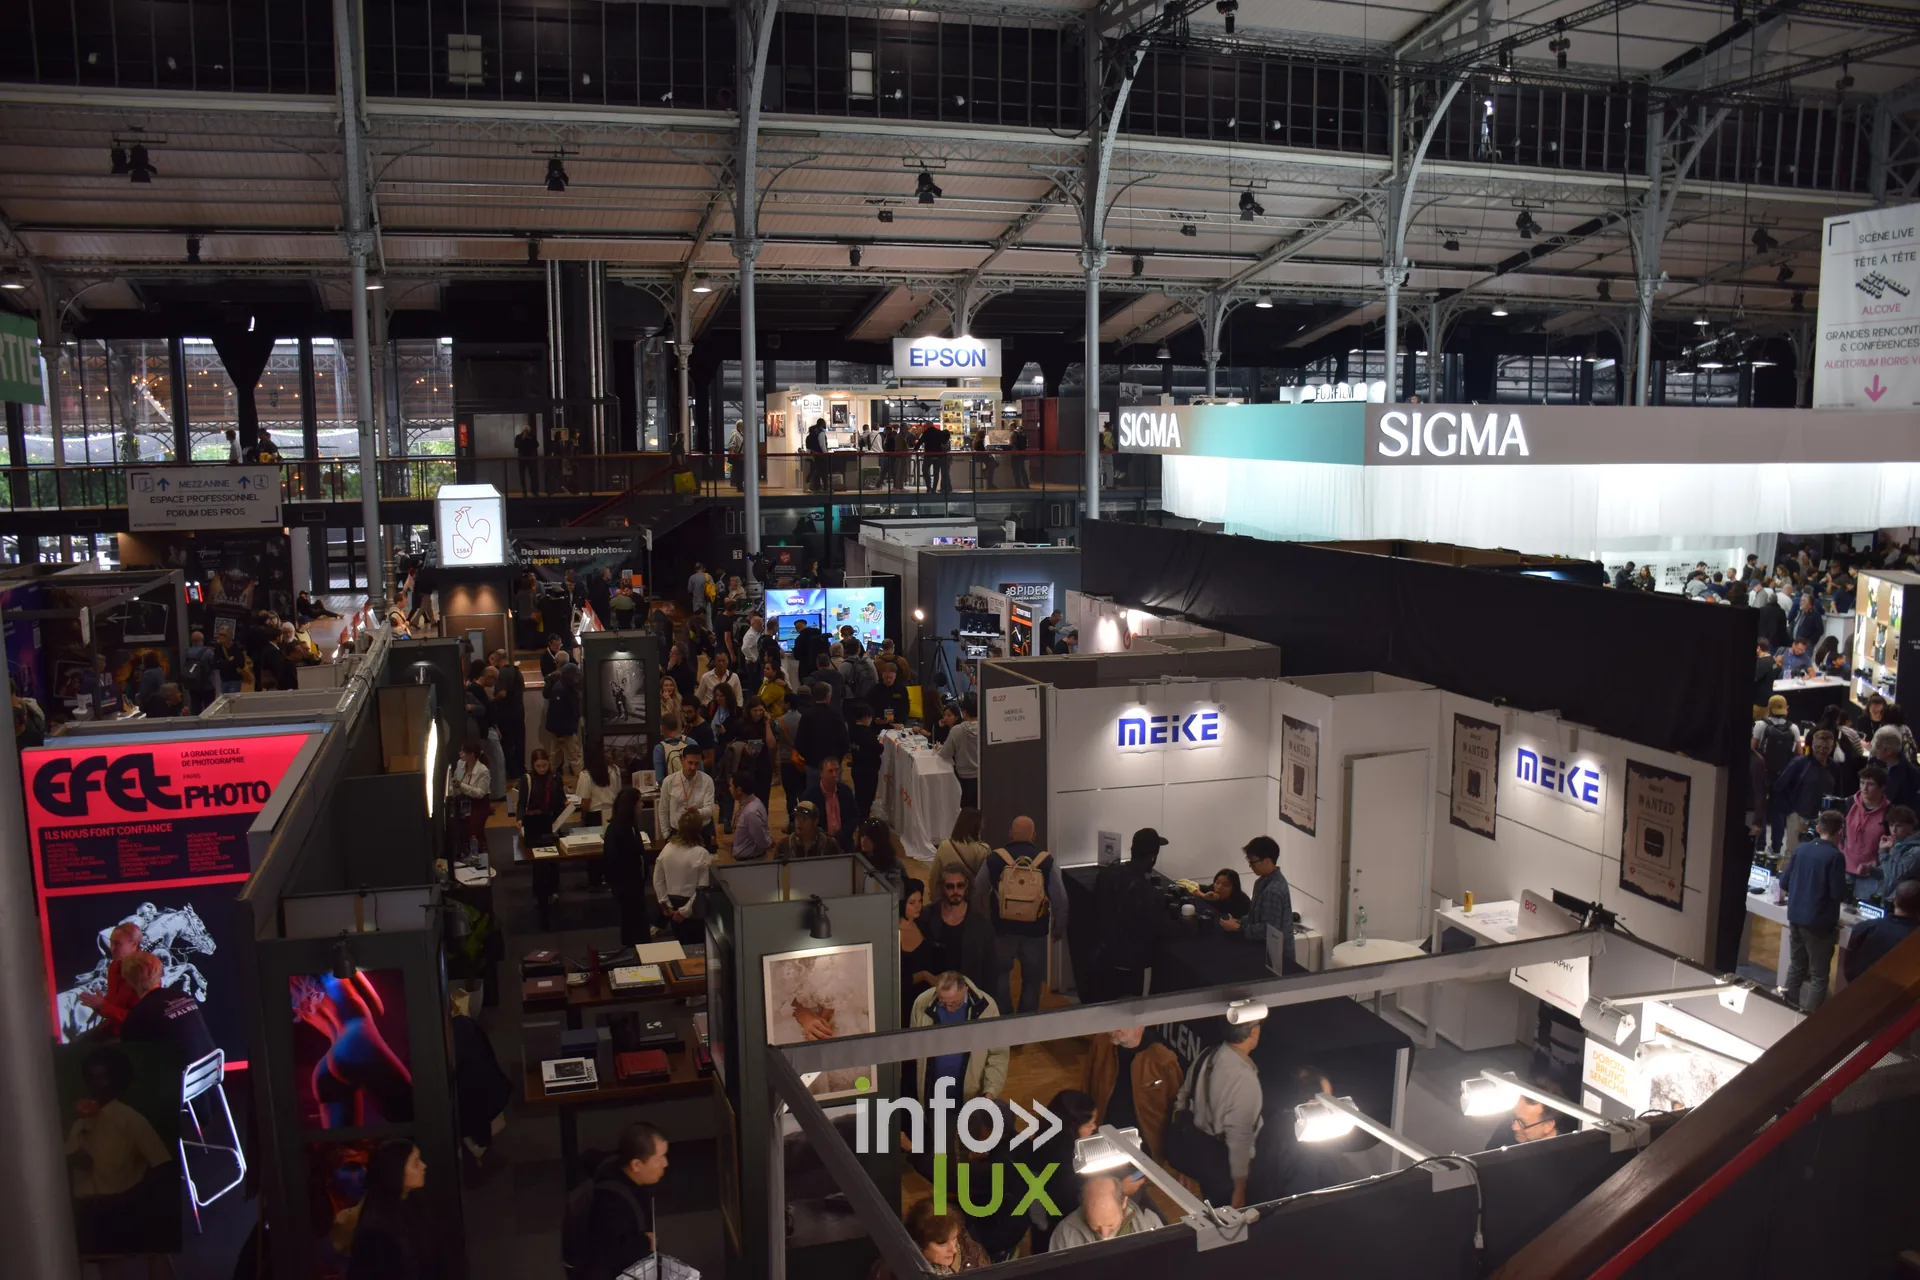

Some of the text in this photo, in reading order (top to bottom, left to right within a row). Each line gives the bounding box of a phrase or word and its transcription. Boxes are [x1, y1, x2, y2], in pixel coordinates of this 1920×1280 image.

[1859, 228, 1915, 244] SCÈNE LIVE
[1854, 256, 1877, 268] TÊTE
[1892, 251, 1917, 263] TÊTE
[1861, 303, 1901, 315] ALCOVE
[1825, 326, 1920, 341] GRANDES RENCONT
[1840, 343, 1848, 352] &
[909, 348, 986, 367] EPSON
[1824, 358, 1879, 369] AUDITORIUM
[1880, 356, 1908, 366] BORIS
[1315, 386, 1354, 400] FUJIFILM
[1120, 412, 1182, 448] SIGMA
[1378, 411, 1530, 457] SIGMA
[178, 480, 230, 489] MEZZANINE
[150, 494, 259, 504] ESPACE PROFESSIONNEL
[166, 508, 246, 517] FORUM DES PROS
[521, 548, 540, 556] Des
[541, 547, 576, 556] milliers
[577, 546, 590, 555] de
[521, 557, 531, 565] et
[532, 557, 560, 567] après
[1010, 585, 1049, 596] SPIDER
[219, 747, 241, 756] ÉCOLE
[1287, 740, 1311, 758] WANTED
[1462, 741, 1489, 760] WANTED
[191, 756, 245, 767] PHOTOGRAPHIE
[184, 781, 271, 809] PHOTO
[1639, 793, 1675, 816] WANTED
[44, 823, 173, 841] ILS NOUS FONT CONFIANCE
[1524, 900, 1537, 915] B12
